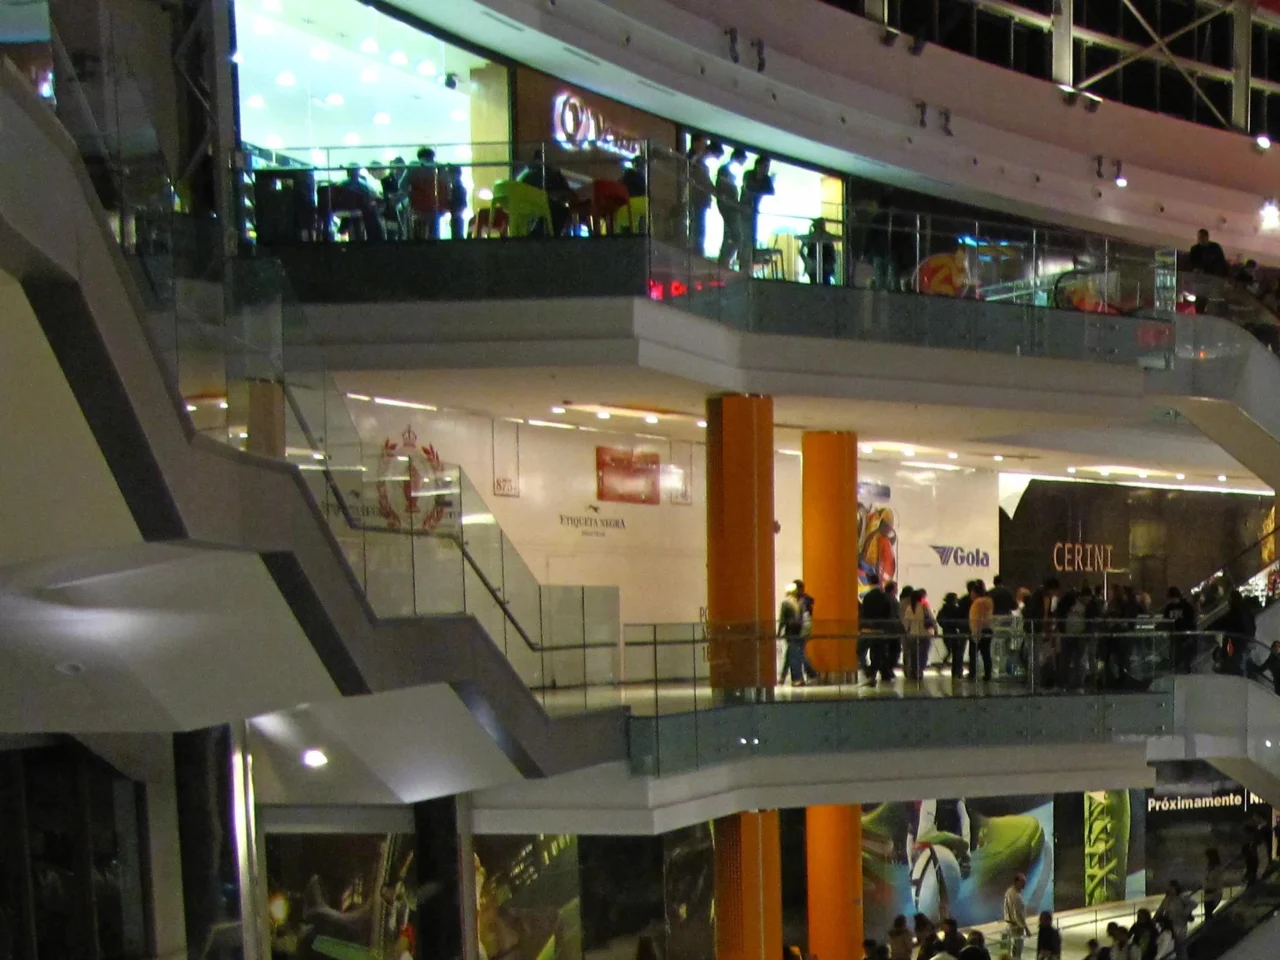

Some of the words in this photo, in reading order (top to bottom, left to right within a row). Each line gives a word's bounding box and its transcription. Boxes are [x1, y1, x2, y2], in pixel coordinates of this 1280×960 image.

[559, 514, 599, 529] ETIQUETA
[599, 517, 626, 529] NEGRA
[953, 547, 990, 568] Gola
[1053, 542, 1114, 572] CERINI
[1147, 792, 1242, 812] Próximamente
